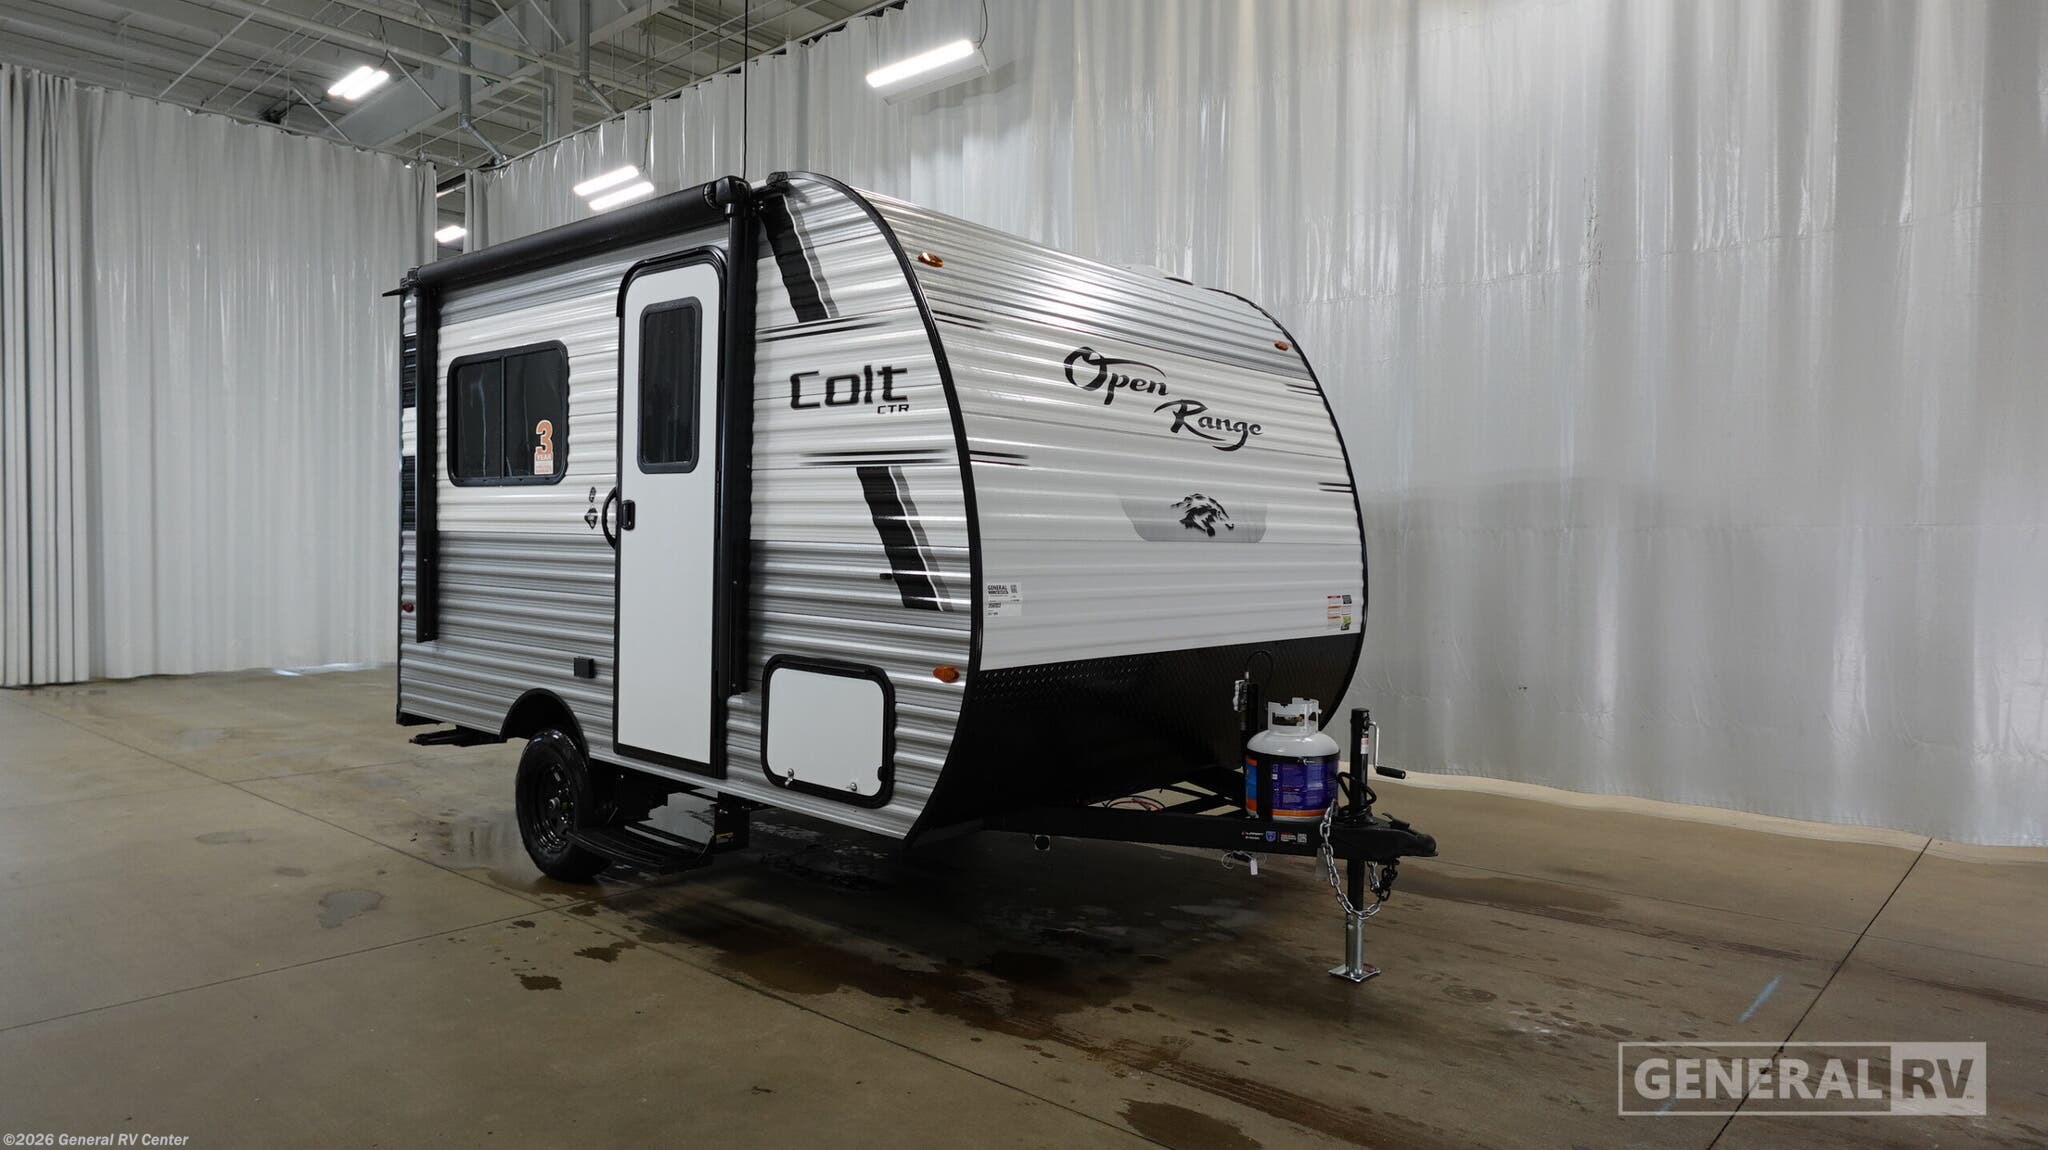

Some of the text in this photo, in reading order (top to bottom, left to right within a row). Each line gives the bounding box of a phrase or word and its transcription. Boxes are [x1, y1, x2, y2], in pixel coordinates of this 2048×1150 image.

[790, 365, 908, 410] Colt
[1064, 347, 1168, 405] Open
[877, 404, 909, 414] CTR
[1154, 399, 1263, 451] Range
[536, 420, 553, 455] 3
